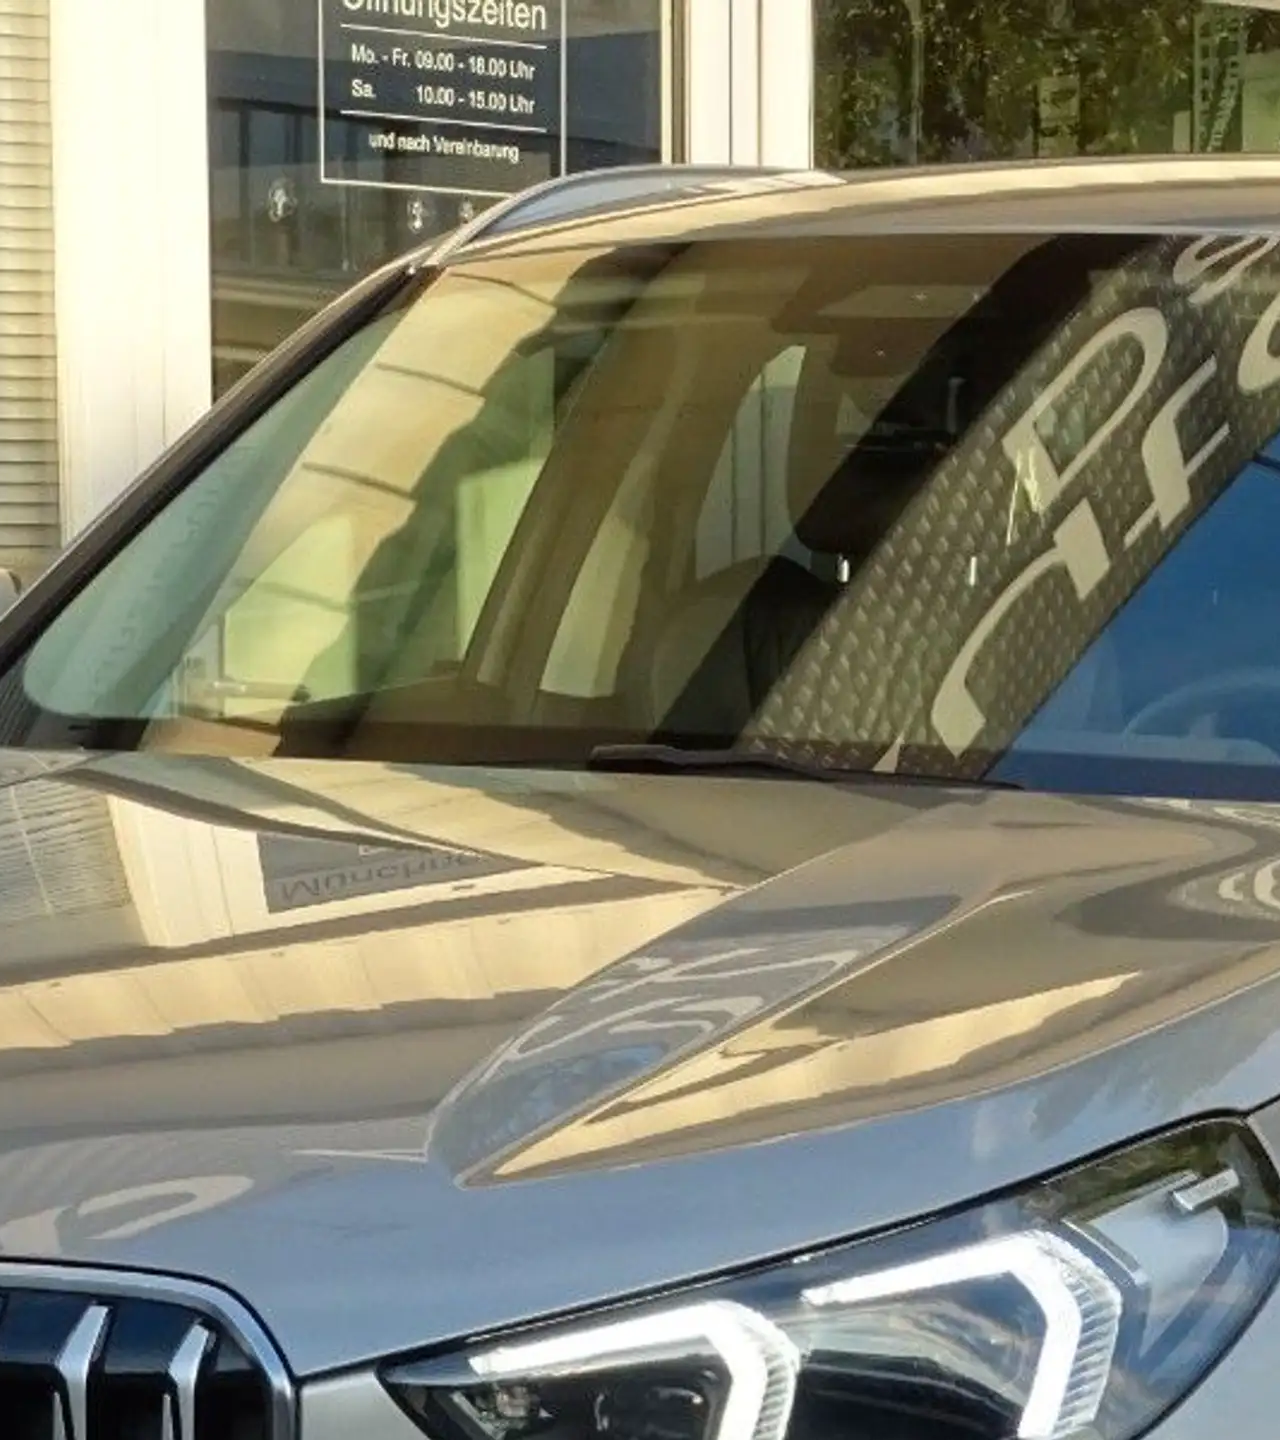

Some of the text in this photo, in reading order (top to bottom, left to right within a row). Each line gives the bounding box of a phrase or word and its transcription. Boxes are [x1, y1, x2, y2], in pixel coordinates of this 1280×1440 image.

[351, 43, 378, 64] Mo.
[392, 47, 411, 68] Fr.
[414, 51, 455, 72] 09.00
[510, 60, 536, 81] Uhr
[351, 79, 377, 98] Sa.
[416, 85, 455, 106] 10.00
[469, 90, 507, 111] 15.00
[510, 94, 536, 115] Uhr
[369, 132, 520, 164] und nach Vereinbarung
